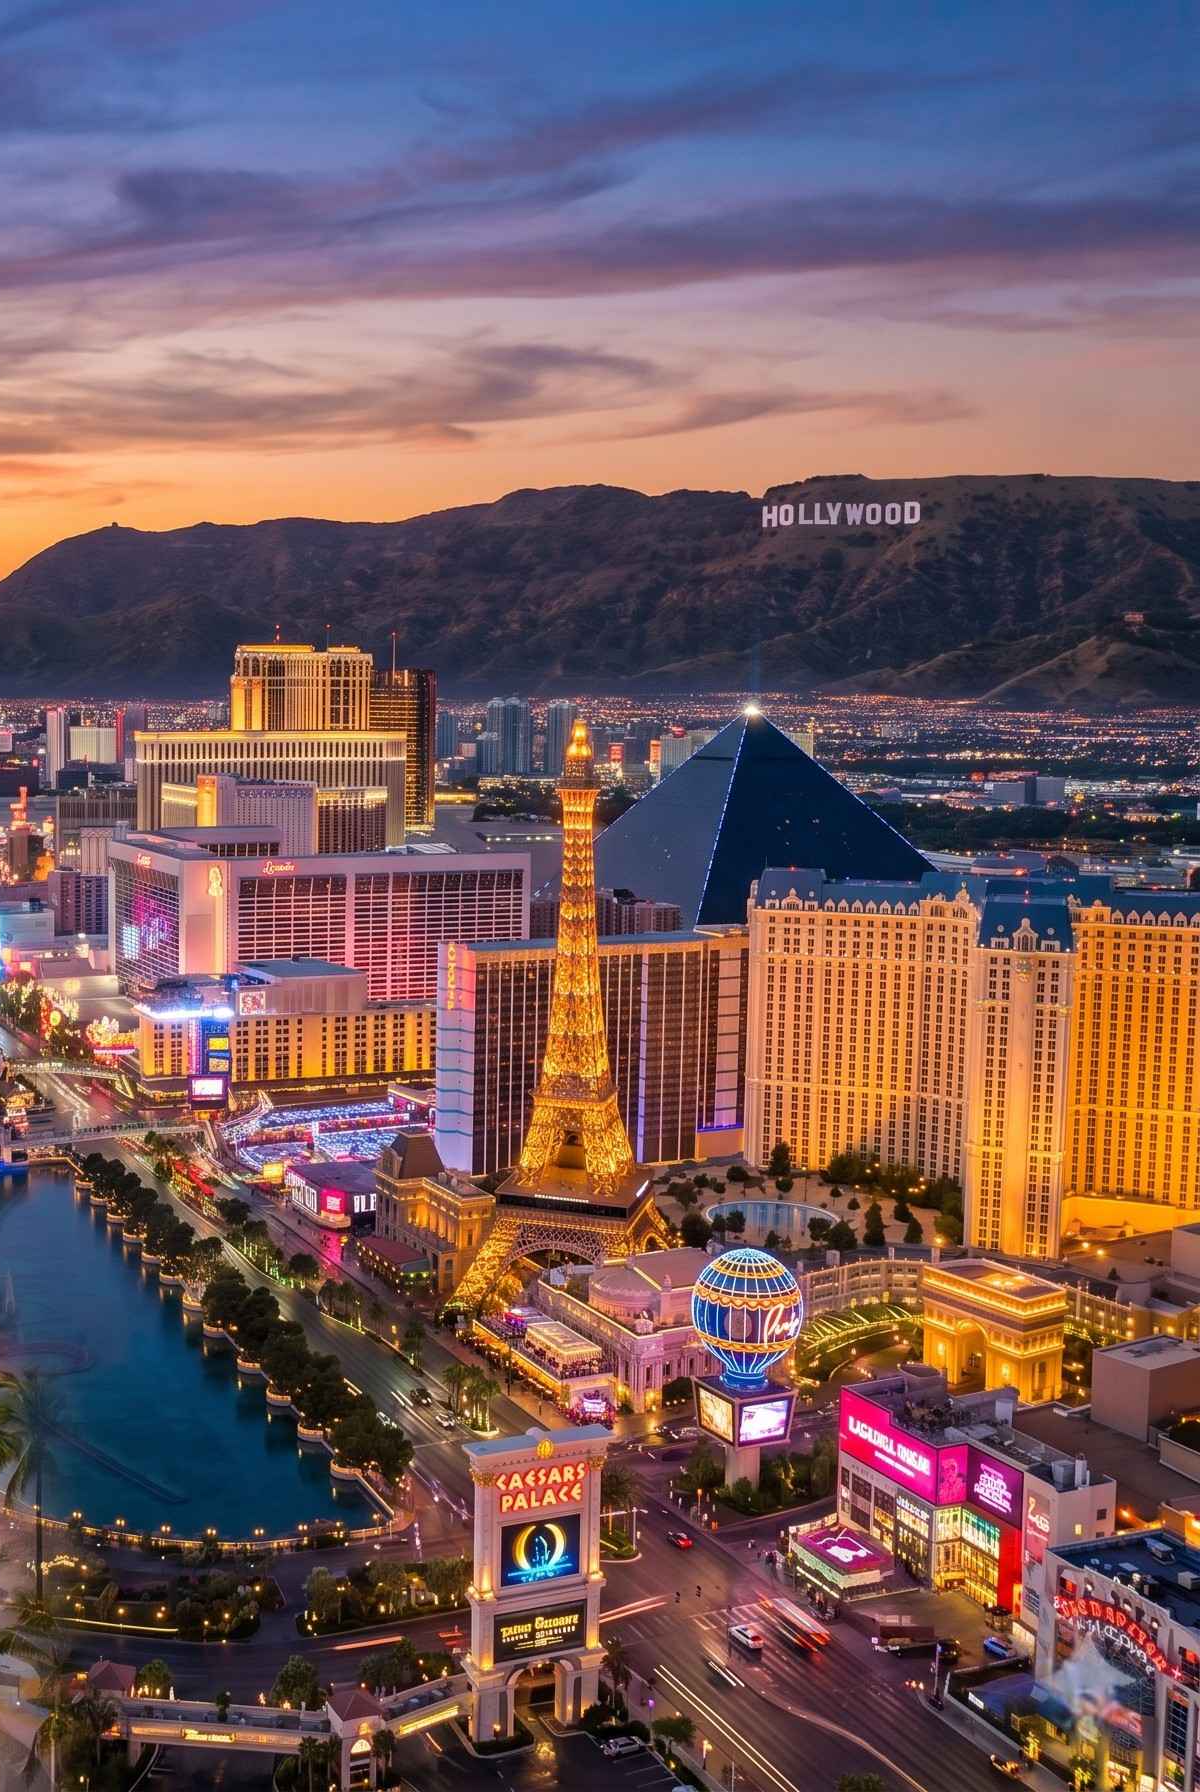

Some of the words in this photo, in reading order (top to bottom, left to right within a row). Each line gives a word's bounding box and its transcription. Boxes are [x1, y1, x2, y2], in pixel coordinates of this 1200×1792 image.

[761, 501, 921, 528] HOLLYWOOD
[496, 1462, 585, 1491] CAESARS
[501, 1482, 582, 1513] PALACE
